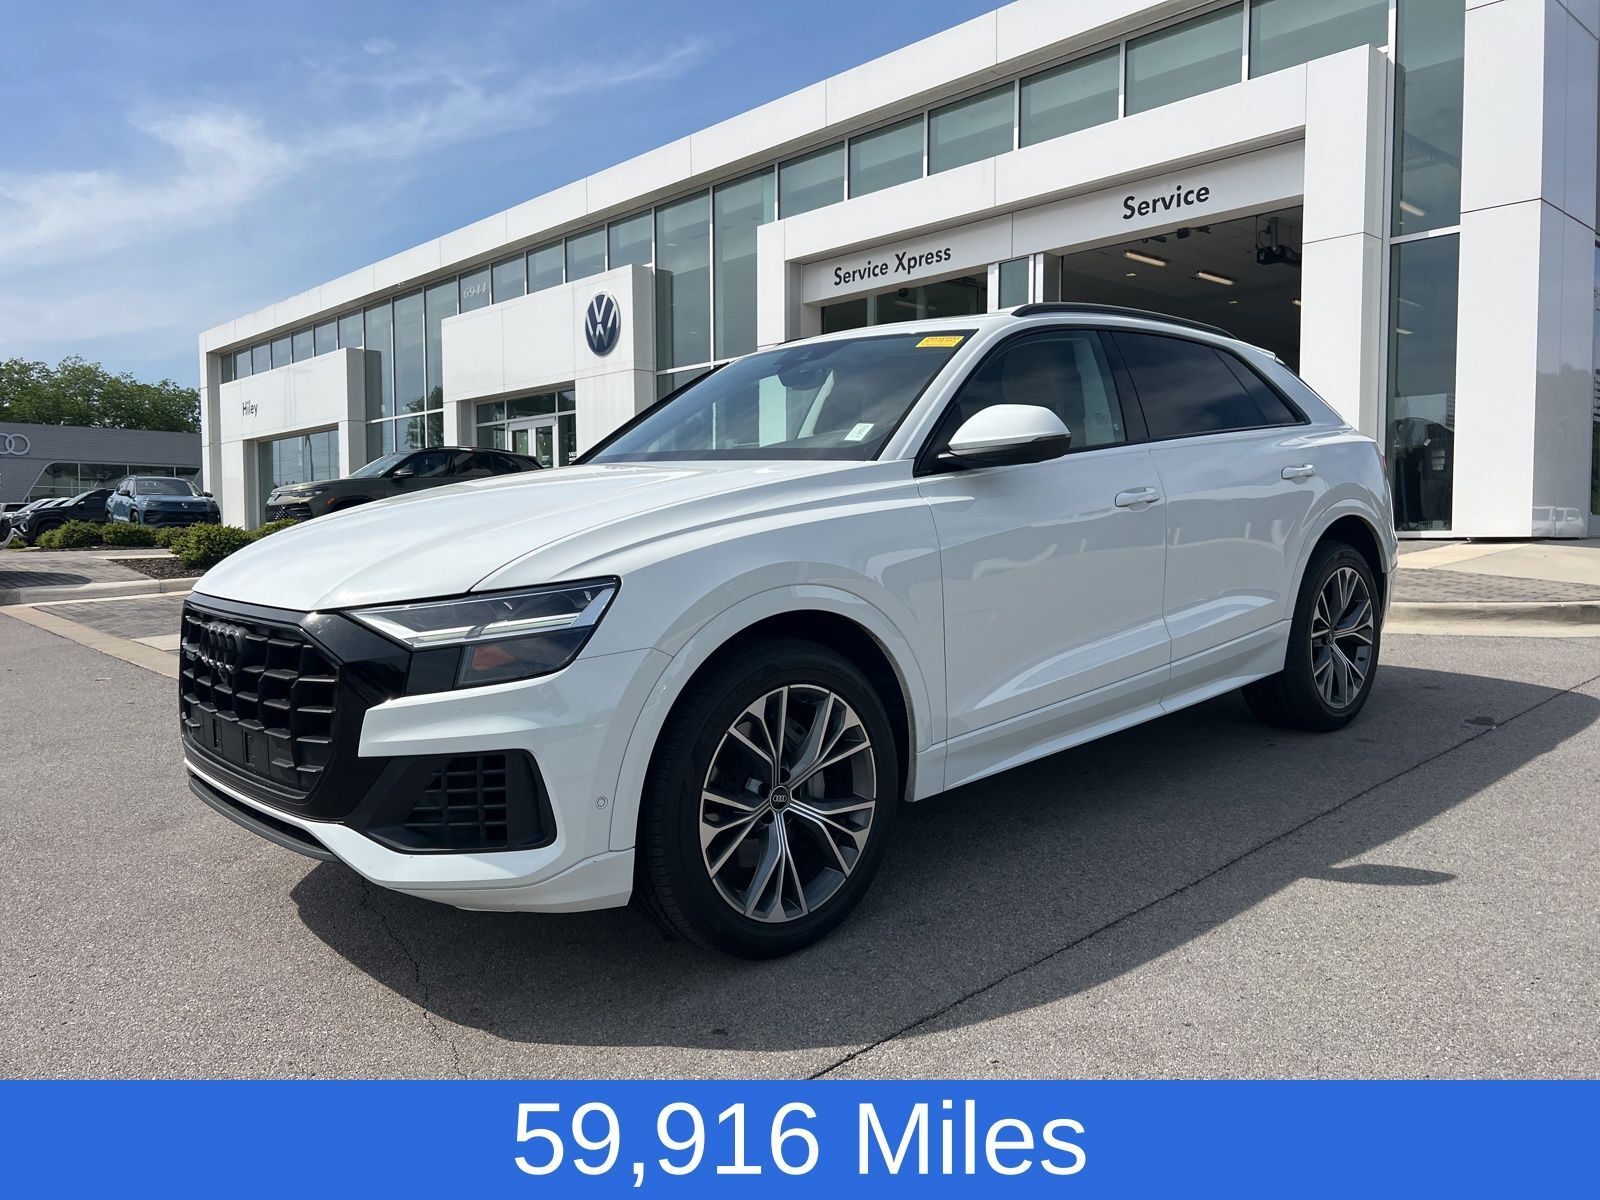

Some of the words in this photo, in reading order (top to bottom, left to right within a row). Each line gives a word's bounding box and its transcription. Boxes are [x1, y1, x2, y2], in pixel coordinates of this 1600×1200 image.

[1122, 184, 1211, 220] Service
[833, 261, 889, 286] Service
[894, 247, 952, 275] Xpress
[463, 280, 488, 299] 6944
[242, 399, 259, 418] Hiley
